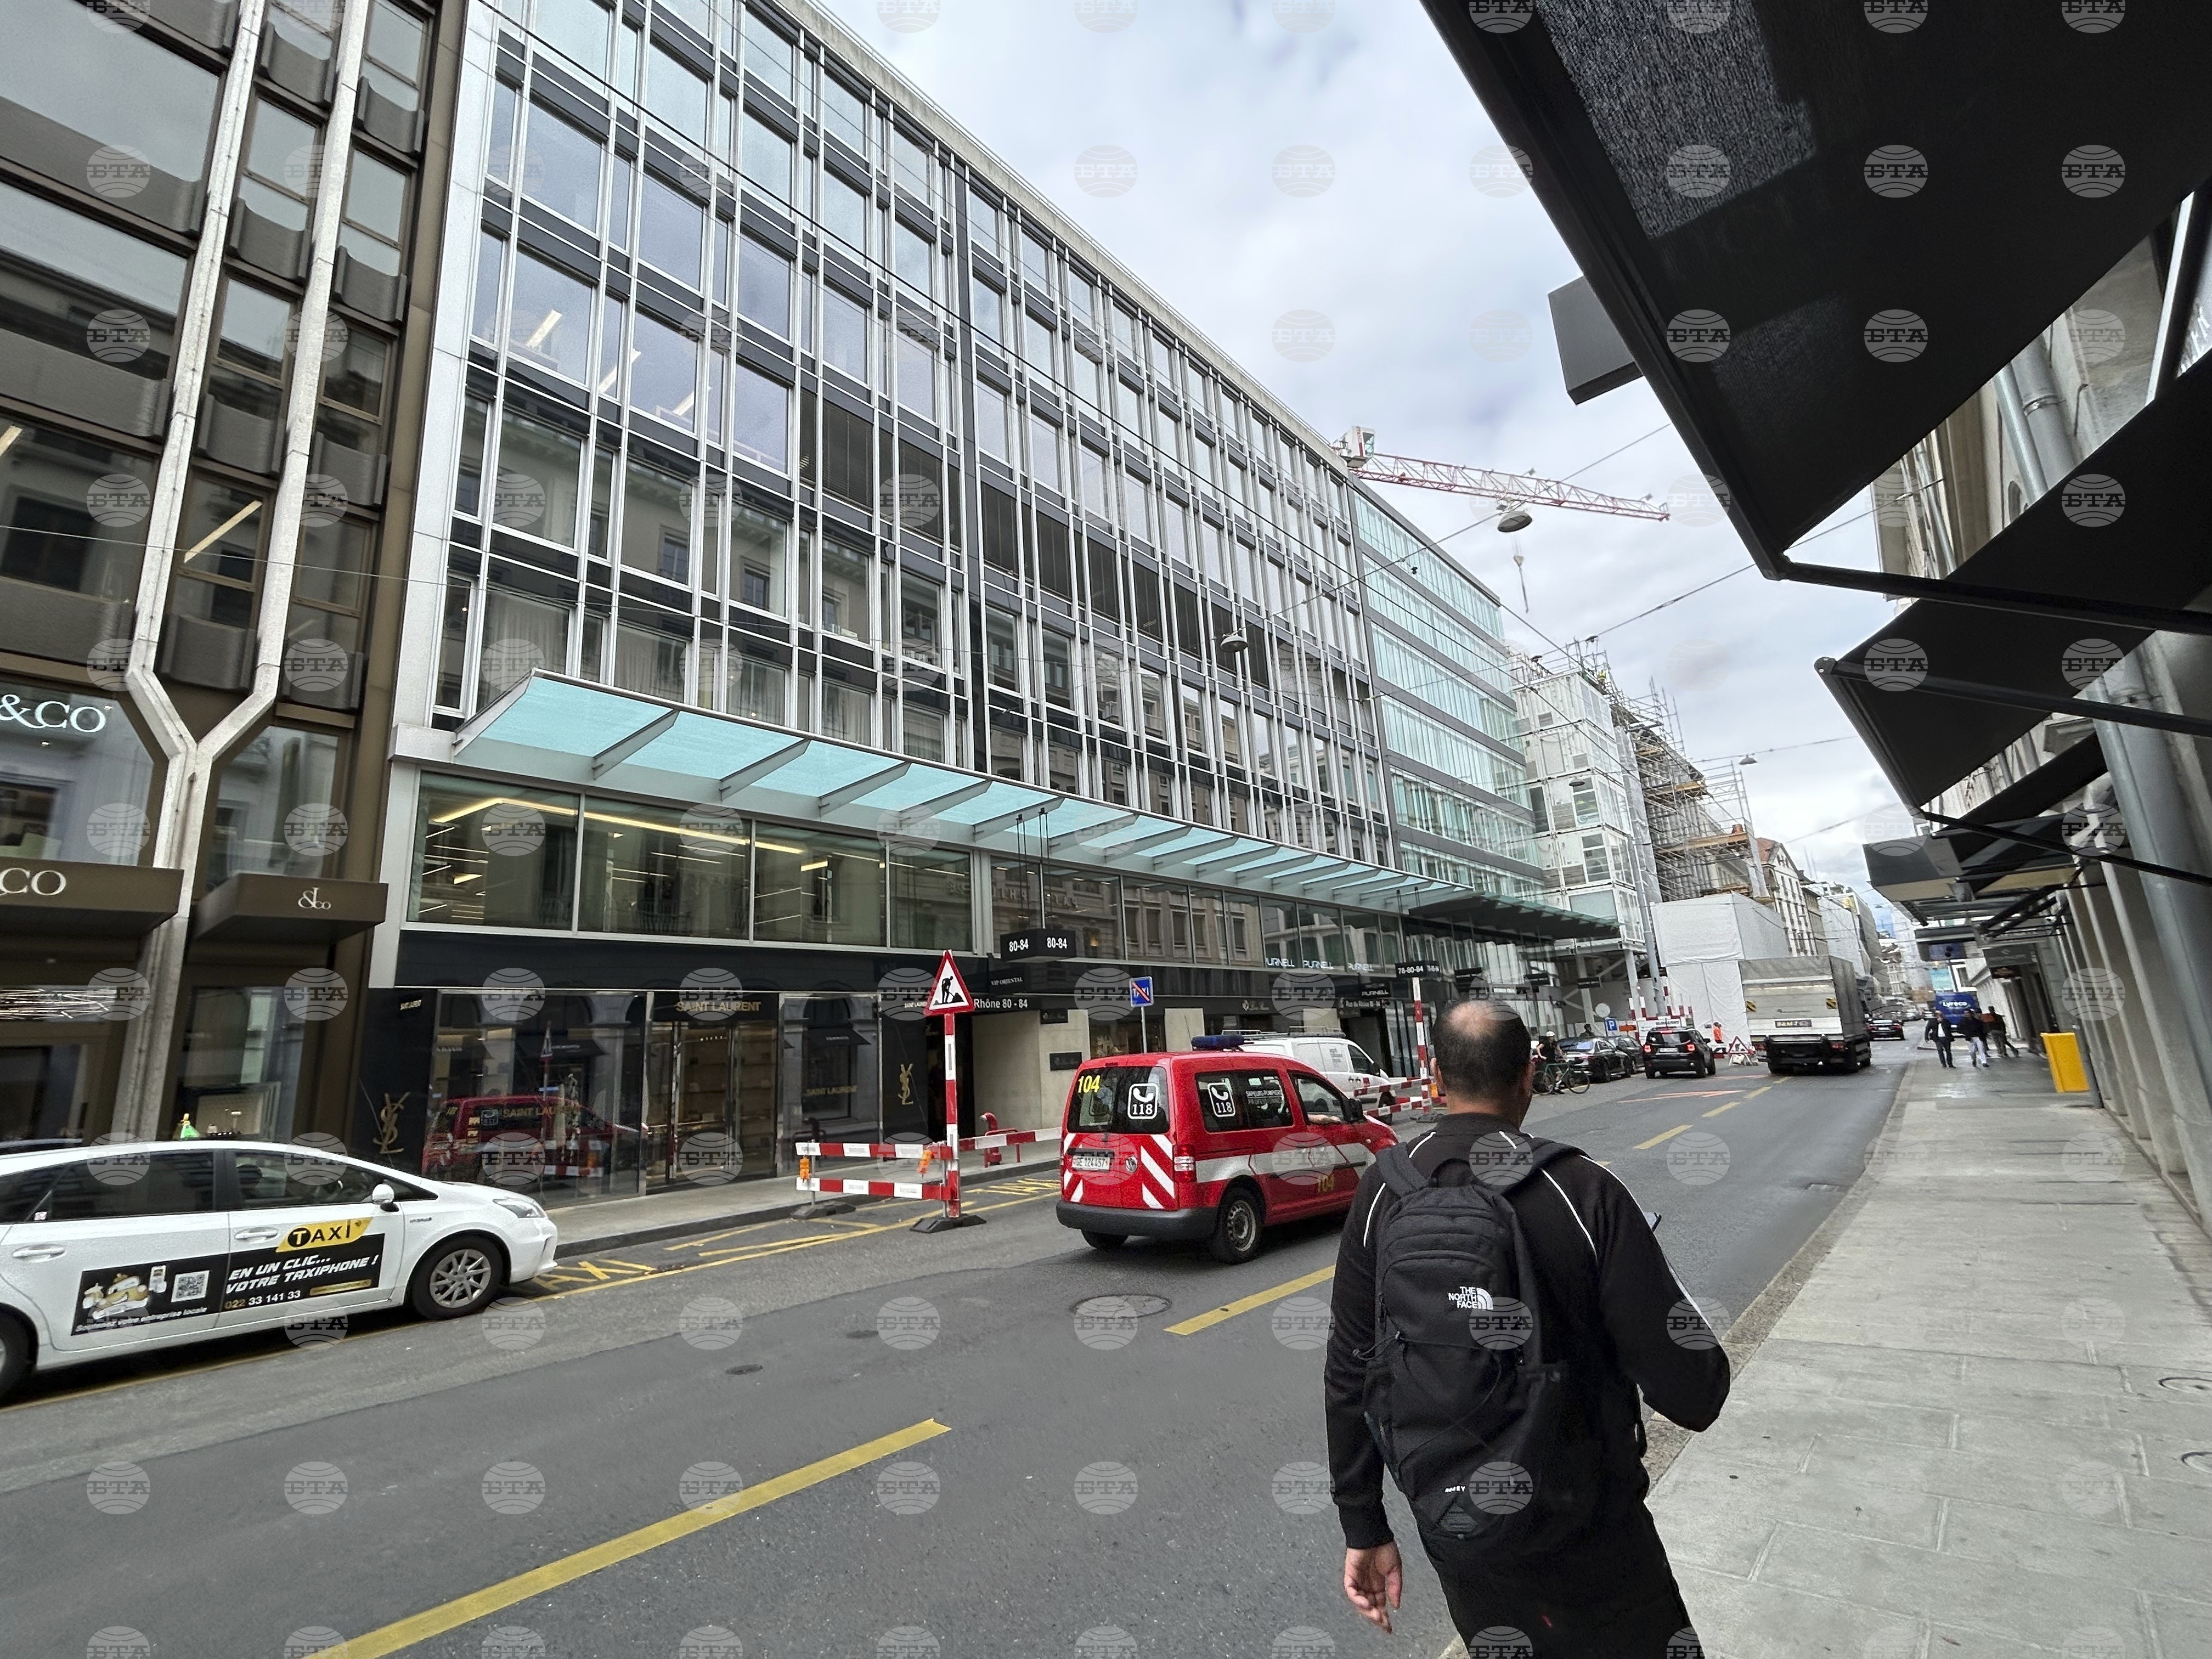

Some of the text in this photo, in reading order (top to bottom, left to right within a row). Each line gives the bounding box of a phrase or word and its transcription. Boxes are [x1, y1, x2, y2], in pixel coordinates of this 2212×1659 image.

[1009, 938, 1029, 952] 80-84
[1047, 937, 1067, 949] 80-84
[1397, 966, 1424, 974] 78-80-84
[676, 1001, 761, 1012] SAINT LAURENT
[974, 998, 1000, 1008] Rhône
[1002, 998, 1012, 1008] 80
[1018, 998, 1028, 1008] 84
[1077, 1075, 1100, 1092] 104
[804, 1088, 826, 1097] SAINT
[503, 1107, 534, 1118] SAINT
[1132, 1104, 1153, 1115] 118
[1216, 1102, 1232, 1113] 118
[1317, 1175, 1335, 1192] 104
[291, 1219, 351, 1246] TAXI
[228, 1254, 331, 1280] EN UN CLIC...
[225, 1274, 280, 1294] VOTRE
[284, 1256, 371, 1283] TAXIPHONE
[532, 1259, 657, 1290] AXI
[1459, 1286, 1476, 1295] THE
[224, 1290, 301, 1310] 022 33 141 33
[1448, 1292, 1477, 1302] NORTH
[1456, 1300, 1479, 1309] FACE
